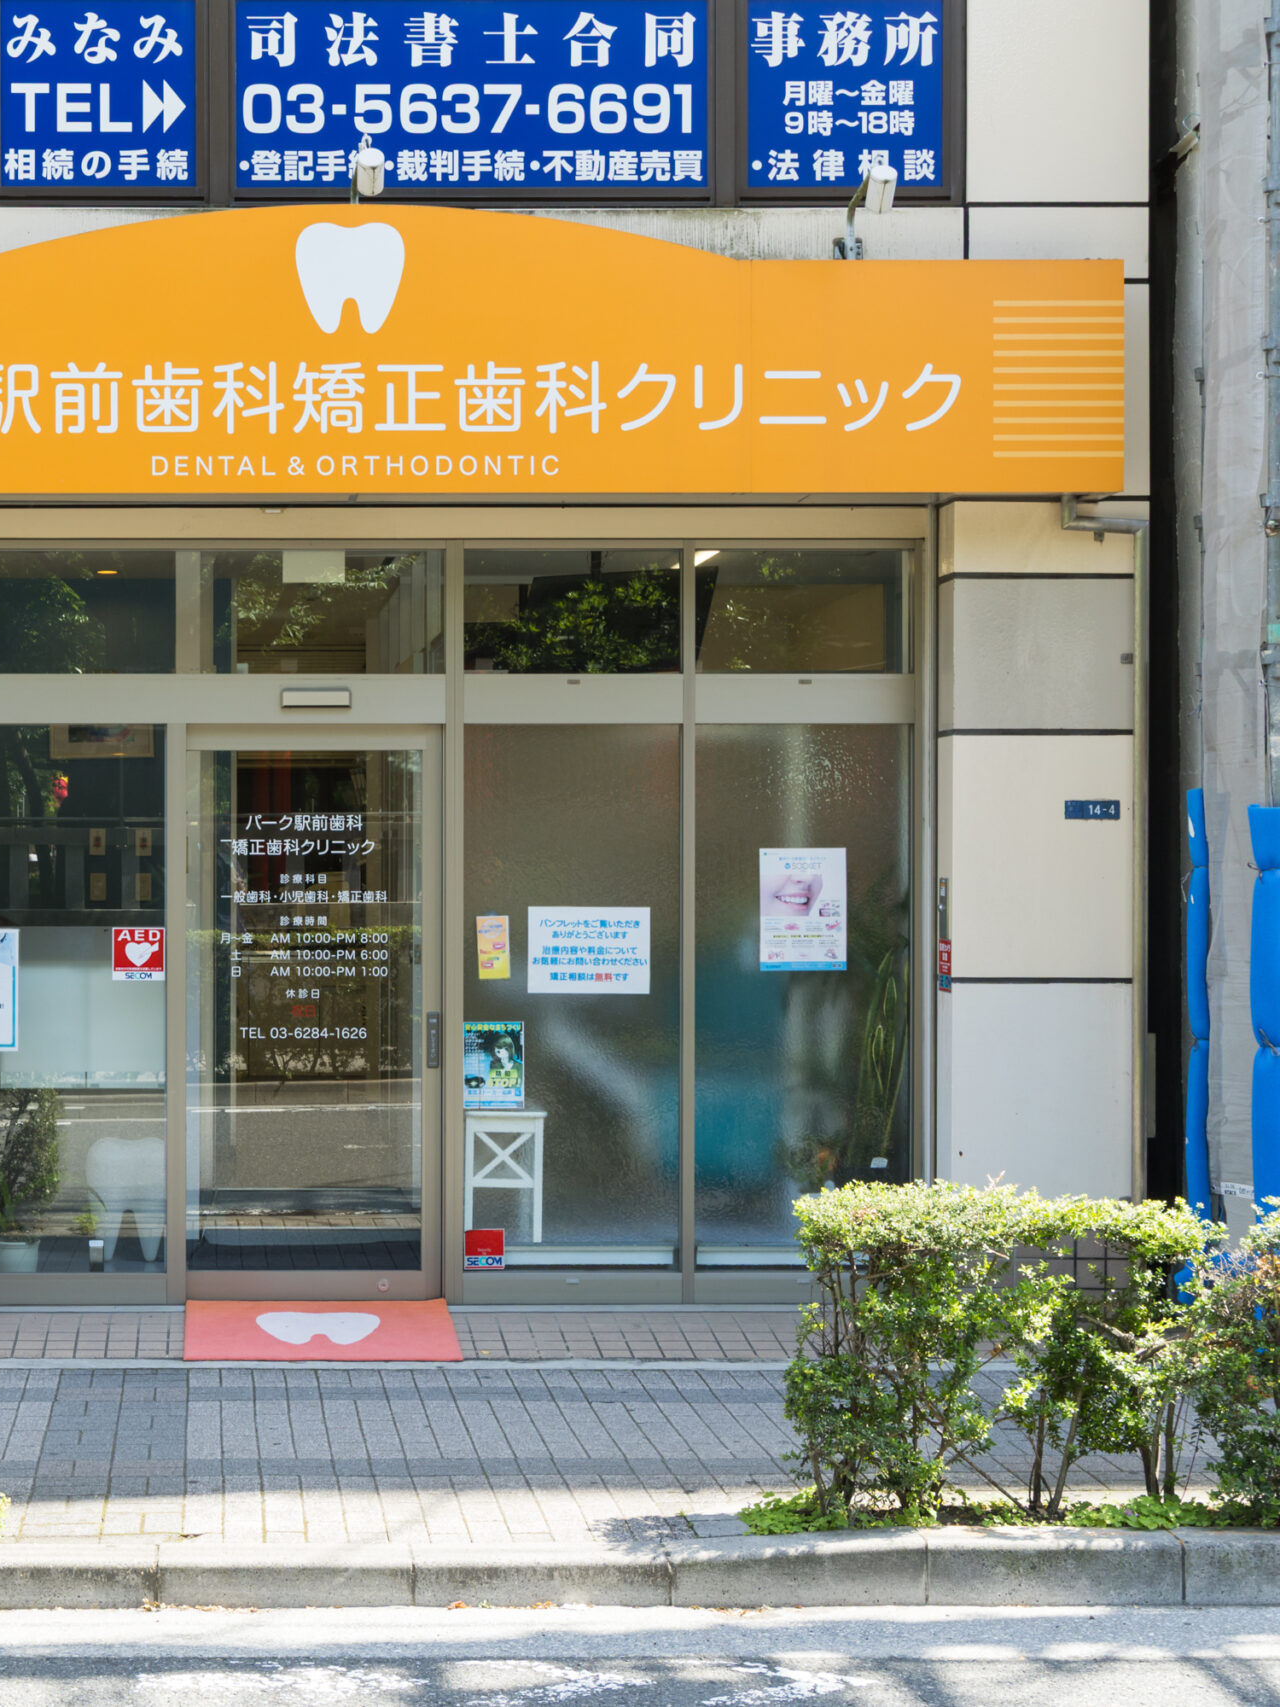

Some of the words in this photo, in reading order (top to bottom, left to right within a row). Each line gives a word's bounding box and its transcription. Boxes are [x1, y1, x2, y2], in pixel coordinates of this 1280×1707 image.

[6, 13, 184, 64] みなみ
[247, 10, 697, 68] 司法書士合同
[751, 10, 940, 68] 事務所
[783, 80, 914, 106] 月曜〜金曜
[11, 83, 134, 133] TEL
[241, 83, 694, 135] 03-5637-6691
[785, 110, 915, 136] 9時〜18時
[4, 148, 188, 181] 相続の手続
[151, 455, 276, 477] DENTAL
[287, 455, 305, 477] &
[316, 455, 561, 477] ORTHODONTIC
[1088, 804, 1115, 815] 14-4
[246, 814, 362, 831] パーク駅前歯科
[231, 839, 376, 856] 矯正歯科クリニック
[280, 874, 327, 884] 診療科目
[221, 890, 387, 903] 一般歯科・小児歯科・矯正歯科
[280, 916, 328, 927] 診療時間
[539, 919, 640, 929] パンフレットをご覧いただき
[117, 930, 161, 941] AED
[270, 933, 291, 944] AM
[296, 933, 356, 944] 10:00-PM
[360, 933, 388, 944] 8:00
[551, 930, 628, 939] ありがとうございます
[231, 950, 242, 961] 土
[270, 950, 291, 960] AM
[296, 950, 356, 960] 10:00-PM
[360, 950, 388, 960] 6:00
[542, 946, 638, 955] 治療内容や料金について
[532, 957, 648, 966] お気軽にお問い合わせください
[231, 967, 241, 977] 日
[270, 967, 291, 977] AM
[296, 967, 356, 977] 10:00-PM
[361, 967, 388, 977] 1:00
[550, 972, 629, 982] 矯正相談は無料です
[285, 989, 320, 999] 休診日
[291, 1005, 315, 1017] 祝日
[240, 1027, 266, 1039] TEL
[270, 1027, 367, 1039] 03-6284-1626
[467, 1256, 502, 1266] SECOM
